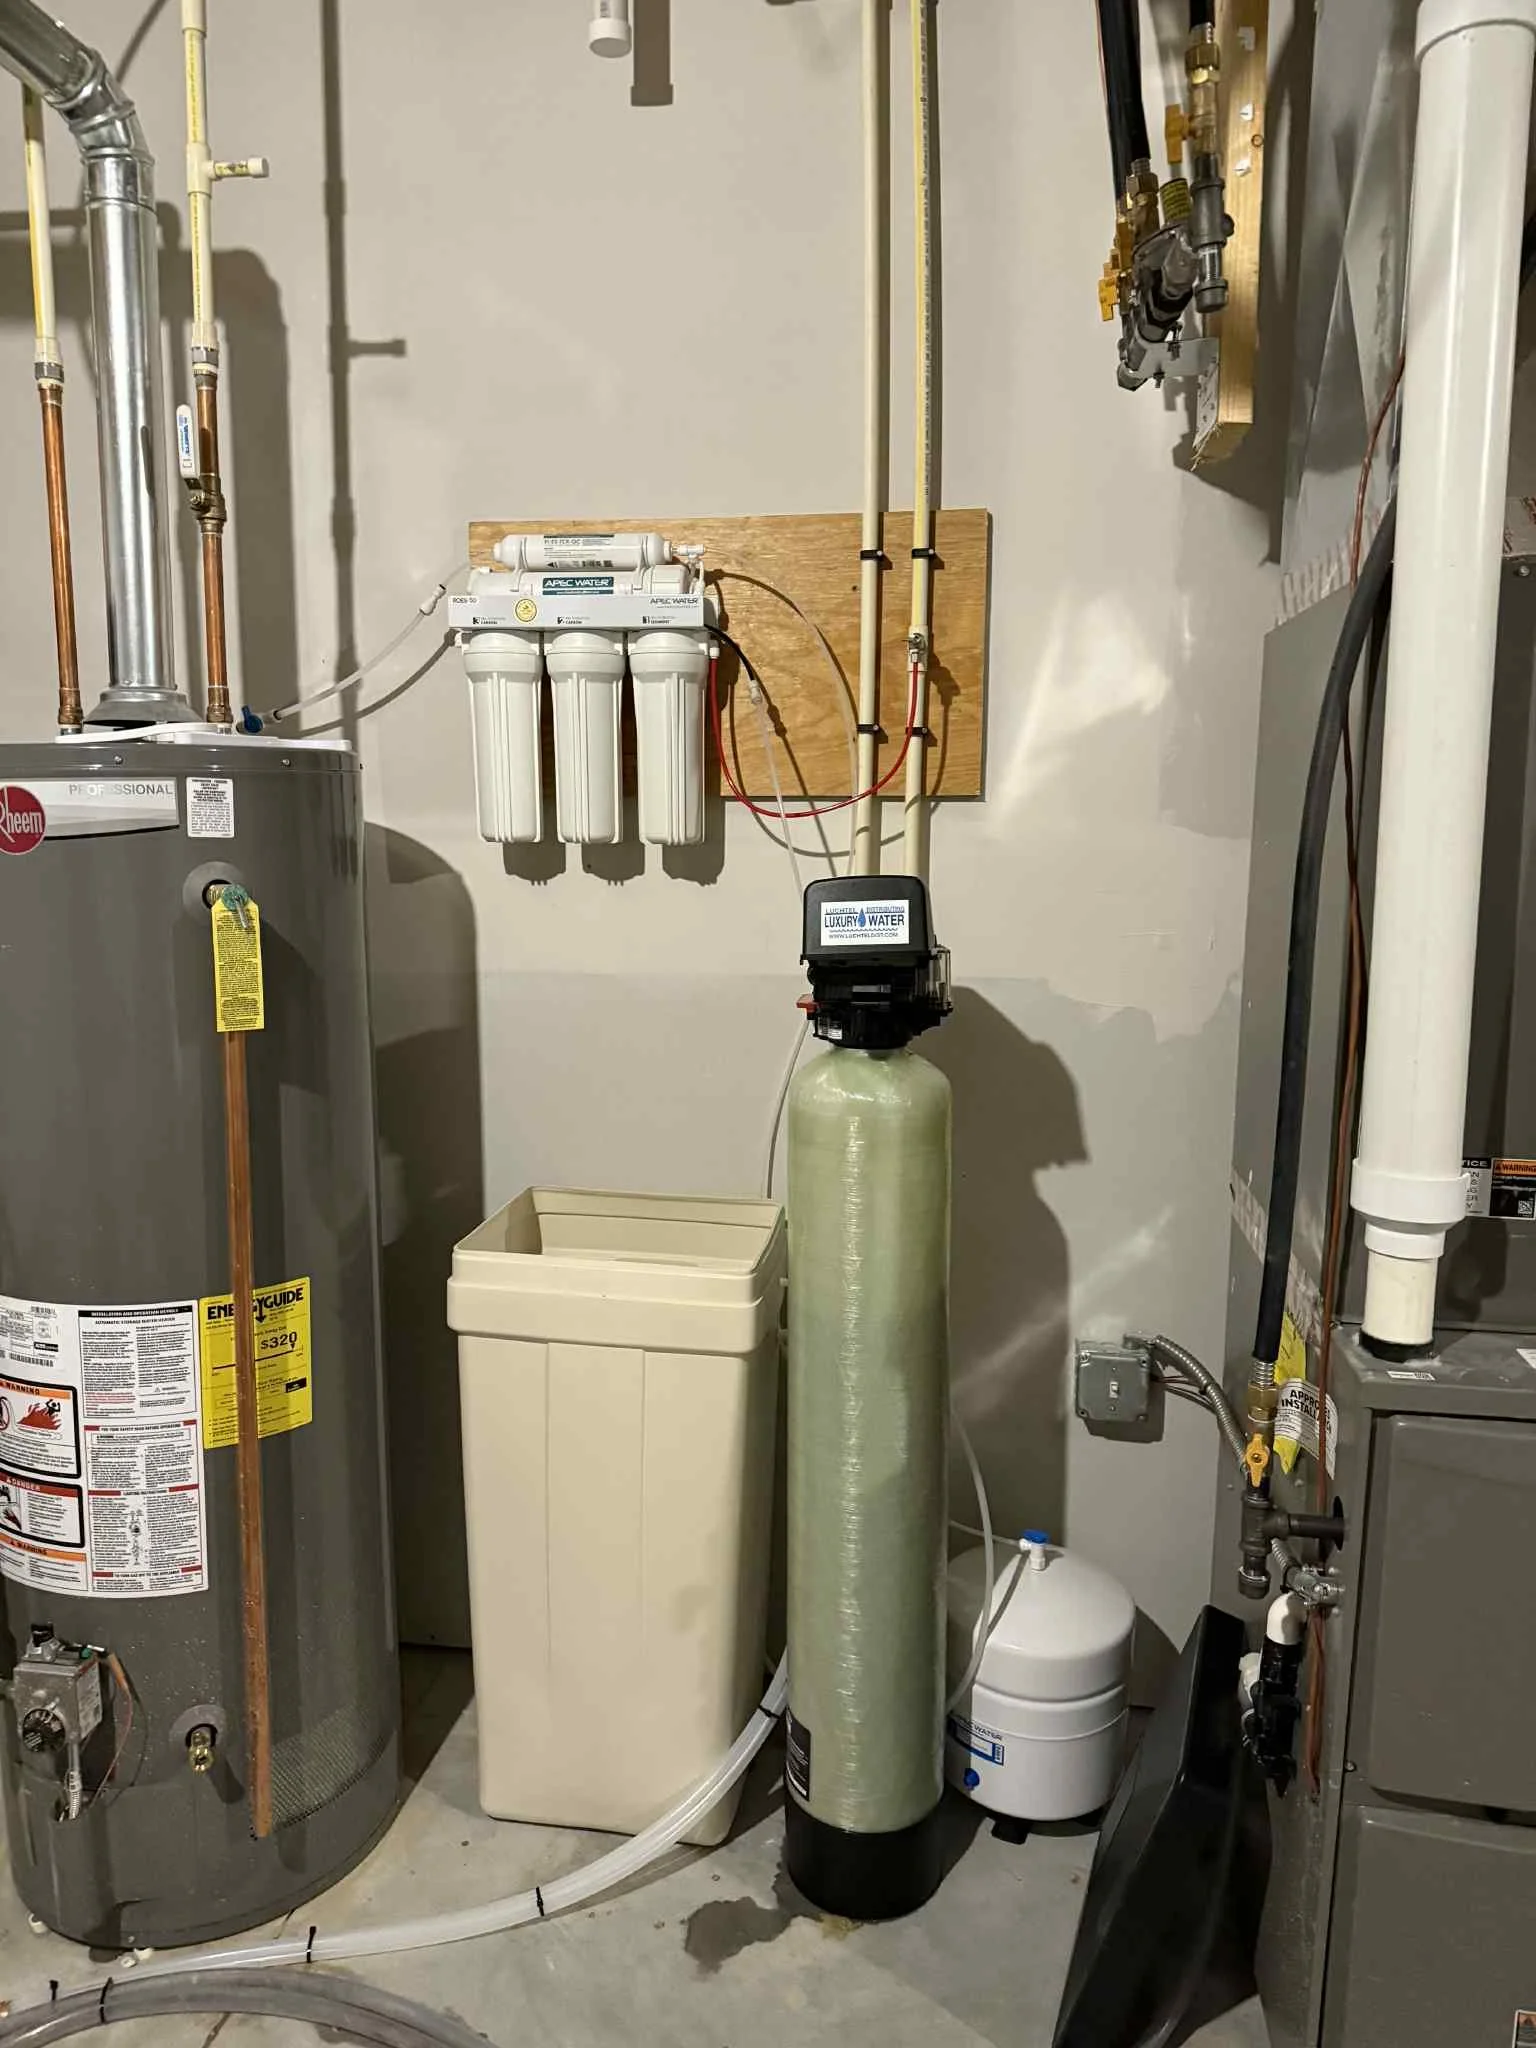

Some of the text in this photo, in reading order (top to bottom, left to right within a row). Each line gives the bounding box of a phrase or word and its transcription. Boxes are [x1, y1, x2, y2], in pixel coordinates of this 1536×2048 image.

[544, 579, 609, 587] APEC WATER
[69, 784, 174, 796] PROFESSIONAL
[825, 914, 905, 928] LUXURY WATER
[207, 1288, 304, 1320] ENEYGUIDE
[260, 1331, 297, 1349] $320
[6, 1382, 40, 1395] WARNING
